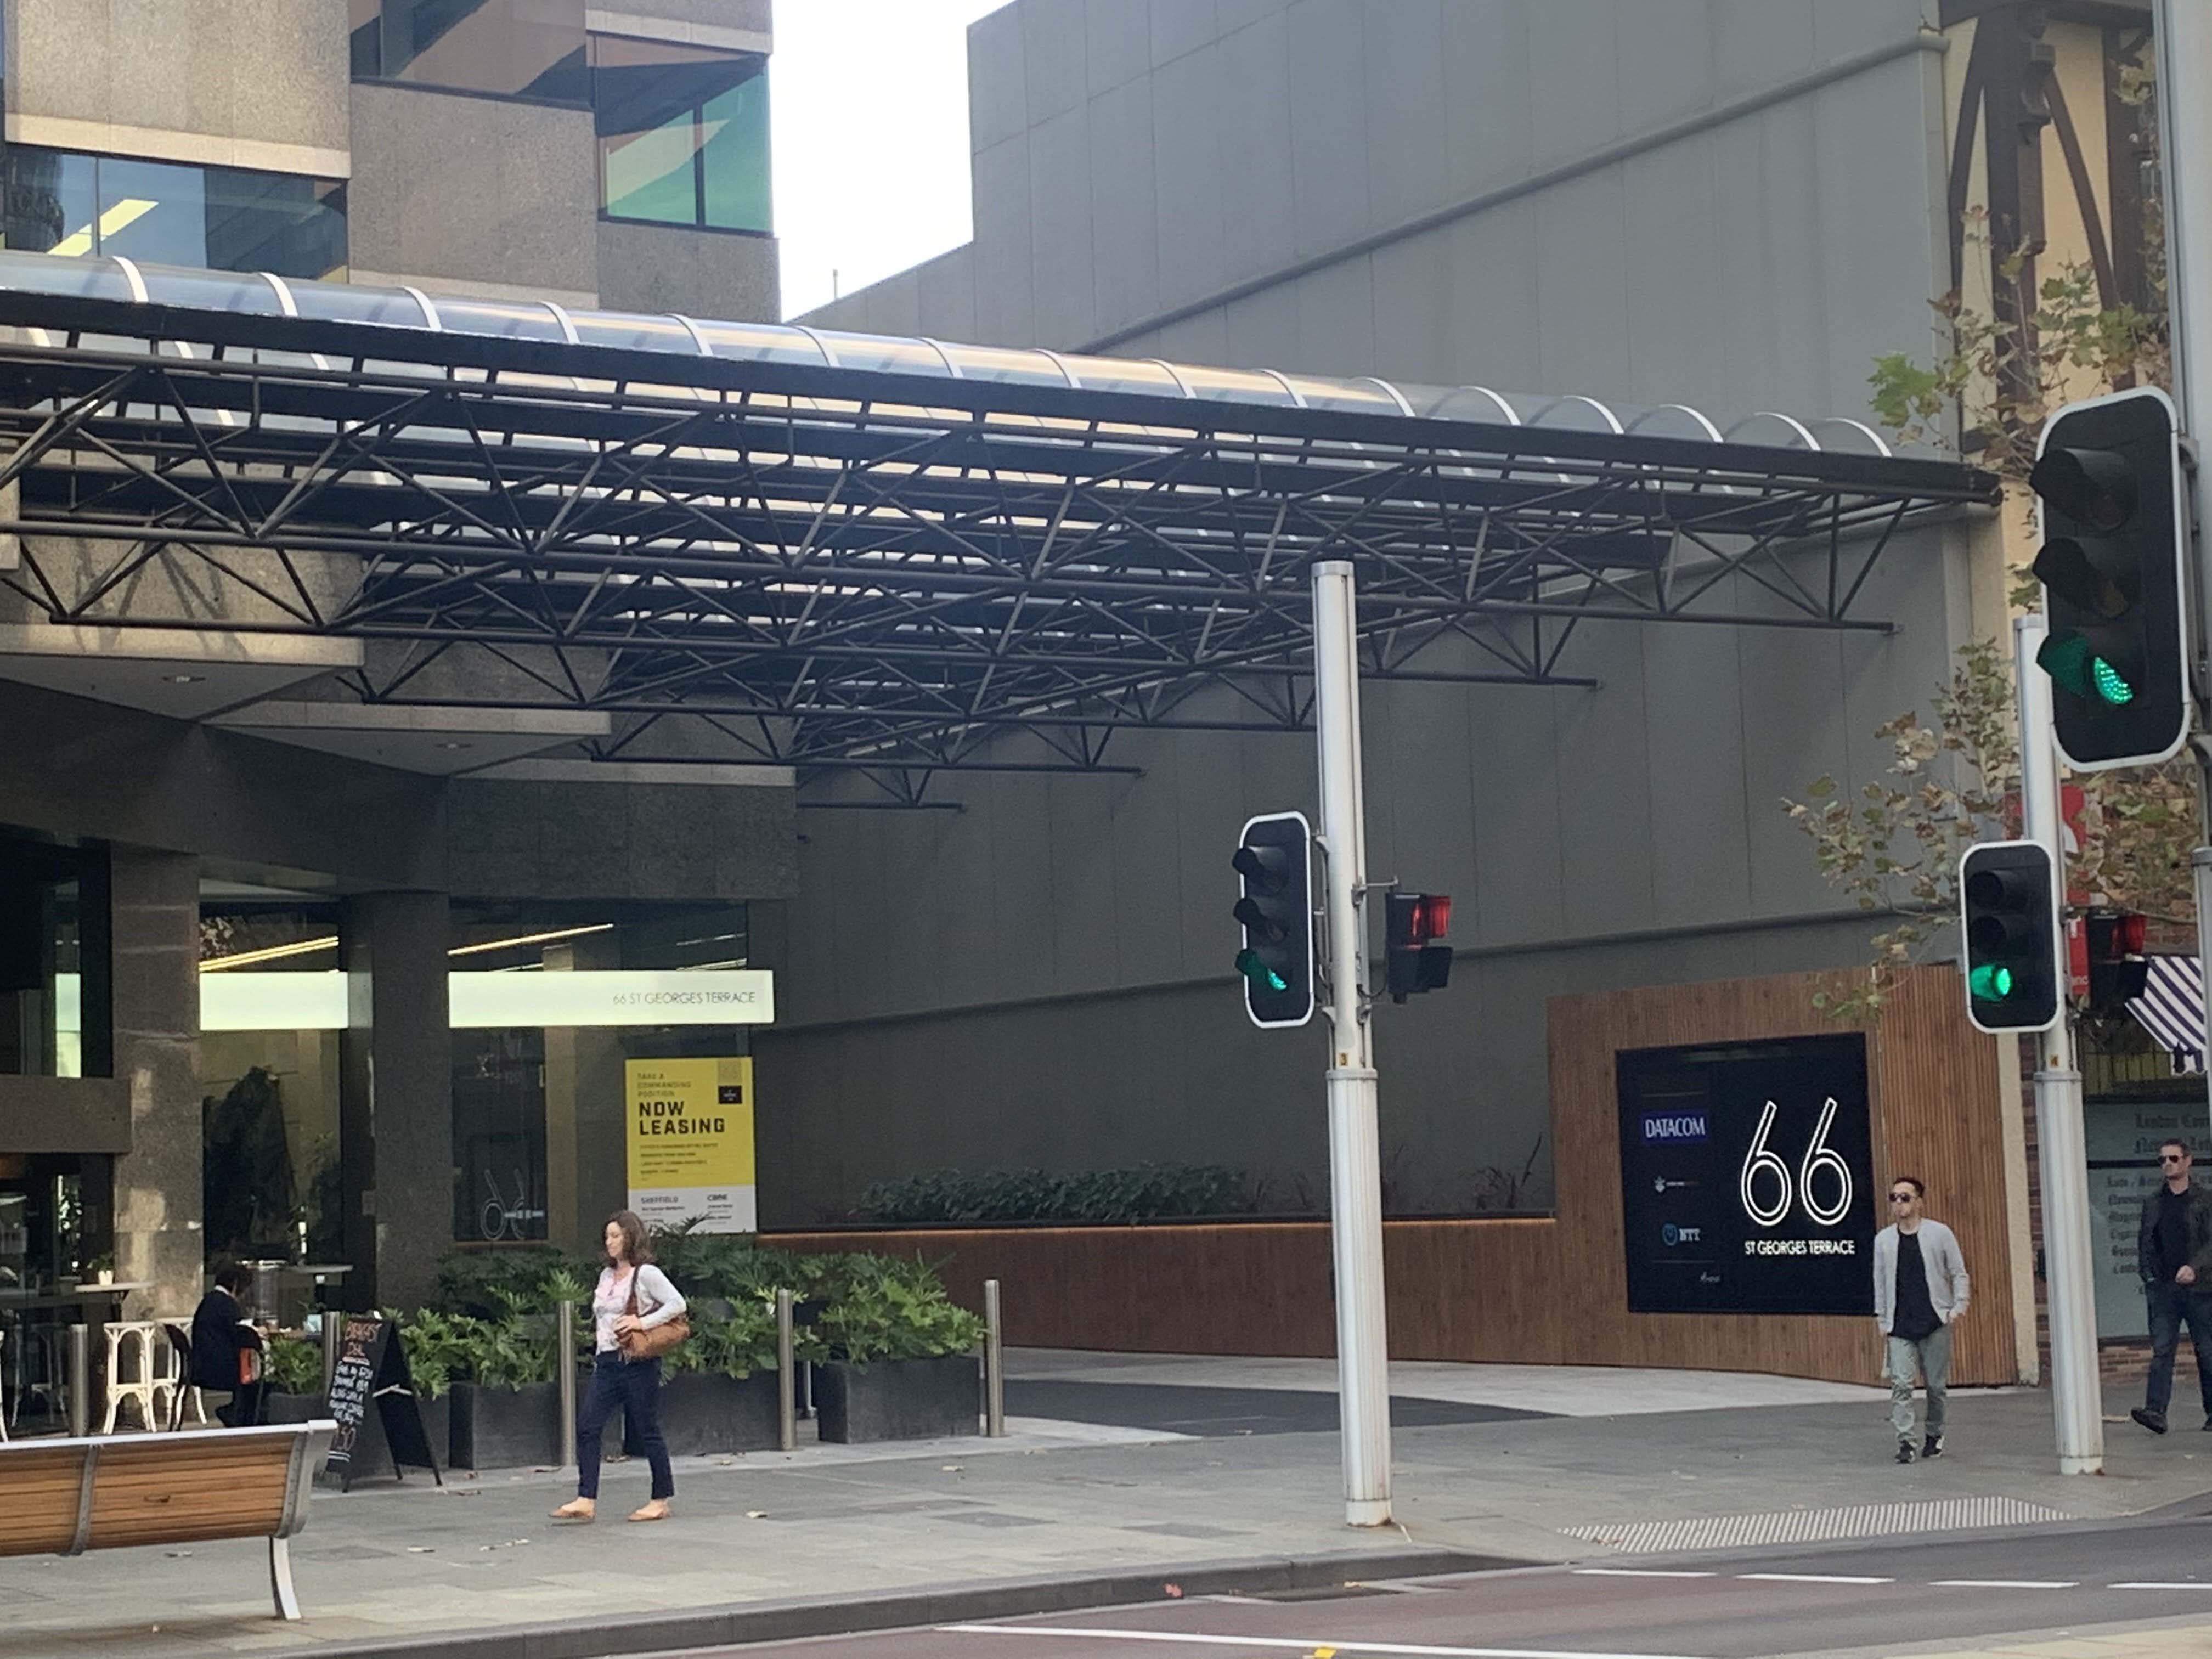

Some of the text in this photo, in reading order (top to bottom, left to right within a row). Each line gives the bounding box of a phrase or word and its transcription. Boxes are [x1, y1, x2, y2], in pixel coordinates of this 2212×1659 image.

[613, 992, 755, 1004] 66 ST GEORGES TERRACE
[639, 1101, 684, 1116] NOW
[640, 1118, 725, 1135] LEASING
[1646, 1117, 1705, 1138] DATACOM
[1741, 1097, 1852, 1226] 66
[1745, 1240, 1855, 1255] ST GEORGES TERRACE
